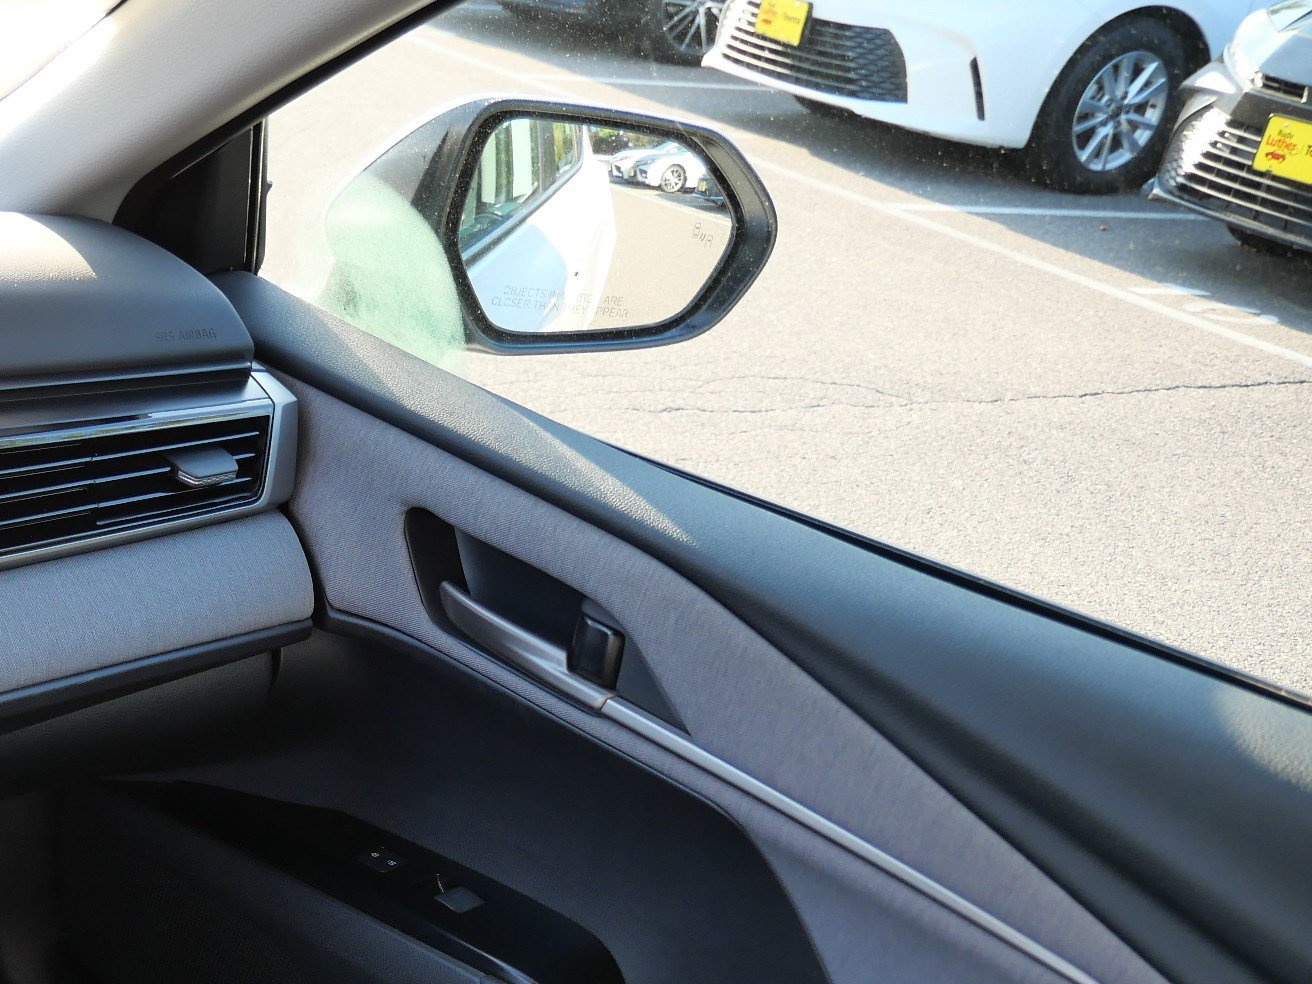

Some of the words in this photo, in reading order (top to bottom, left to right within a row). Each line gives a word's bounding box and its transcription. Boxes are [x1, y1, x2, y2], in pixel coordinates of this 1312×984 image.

[1266, 134, 1297, 151] Luther
[503, 285, 546, 299] OBJECTS
[603, 295, 624, 307] ARE
[491, 295, 530, 309] CLOSER
[590, 305, 629, 319] PPEAR
[177, 327, 217, 341] AIRBAG
